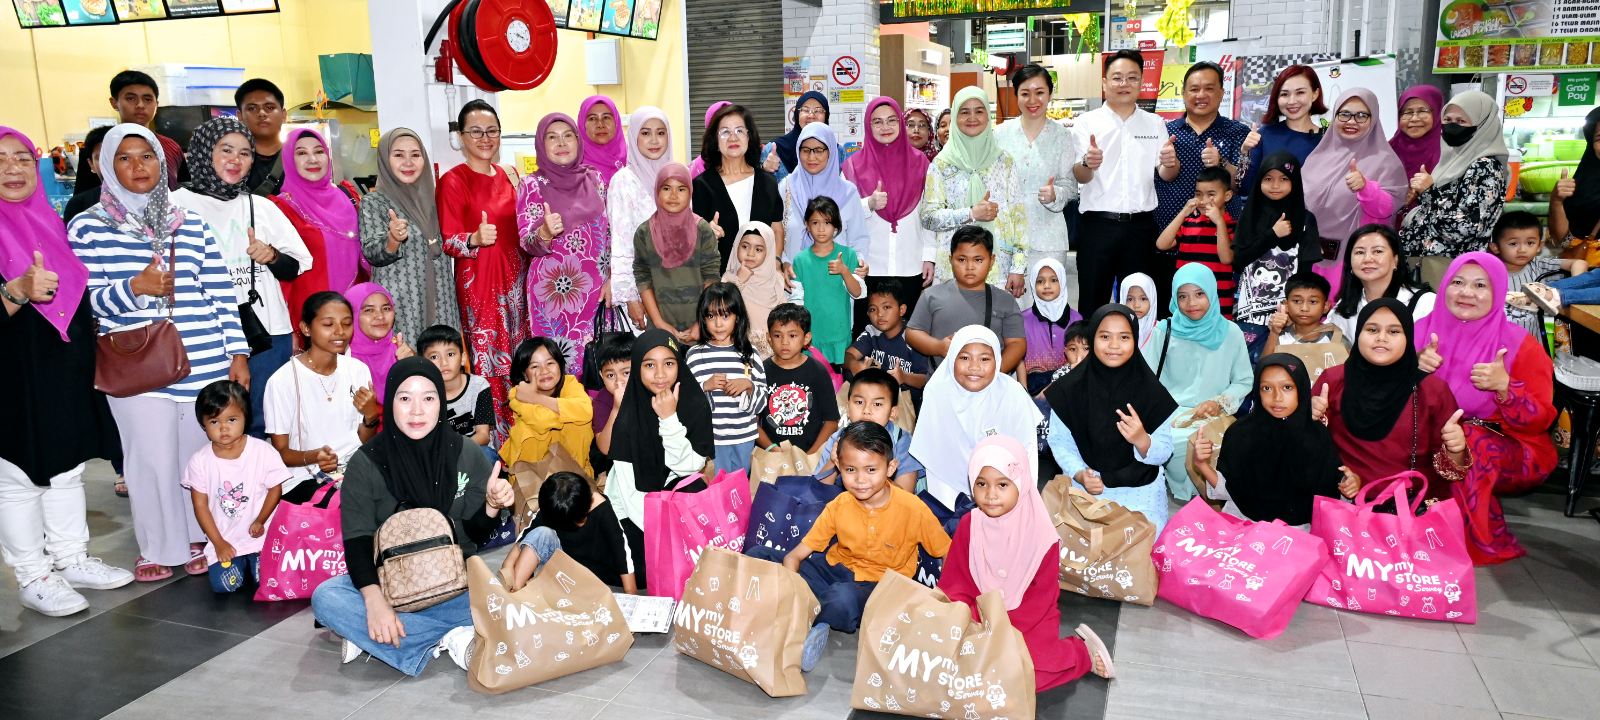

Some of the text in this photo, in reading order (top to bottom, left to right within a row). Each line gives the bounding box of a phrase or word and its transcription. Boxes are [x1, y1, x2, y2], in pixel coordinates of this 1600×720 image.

[1566, 83, 1590, 92] Grab
[1567, 92, 1587, 102] Pay
[775, 426, 804, 436] GEAR5
[280, 548, 324, 572] MY
[323, 549, 345, 562] my
[1213, 551, 1257, 573] STORE
[1346, 553, 1394, 582] MY
[1394, 561, 1414, 573] my
[1395, 572, 1441, 585] STORE
[674, 600, 706, 634] MY
[705, 609, 725, 627] my
[703, 623, 741, 644] STORE
[887, 643, 943, 683] MY
[941, 657, 959, 677] my
[937, 672, 984, 690] STORE
